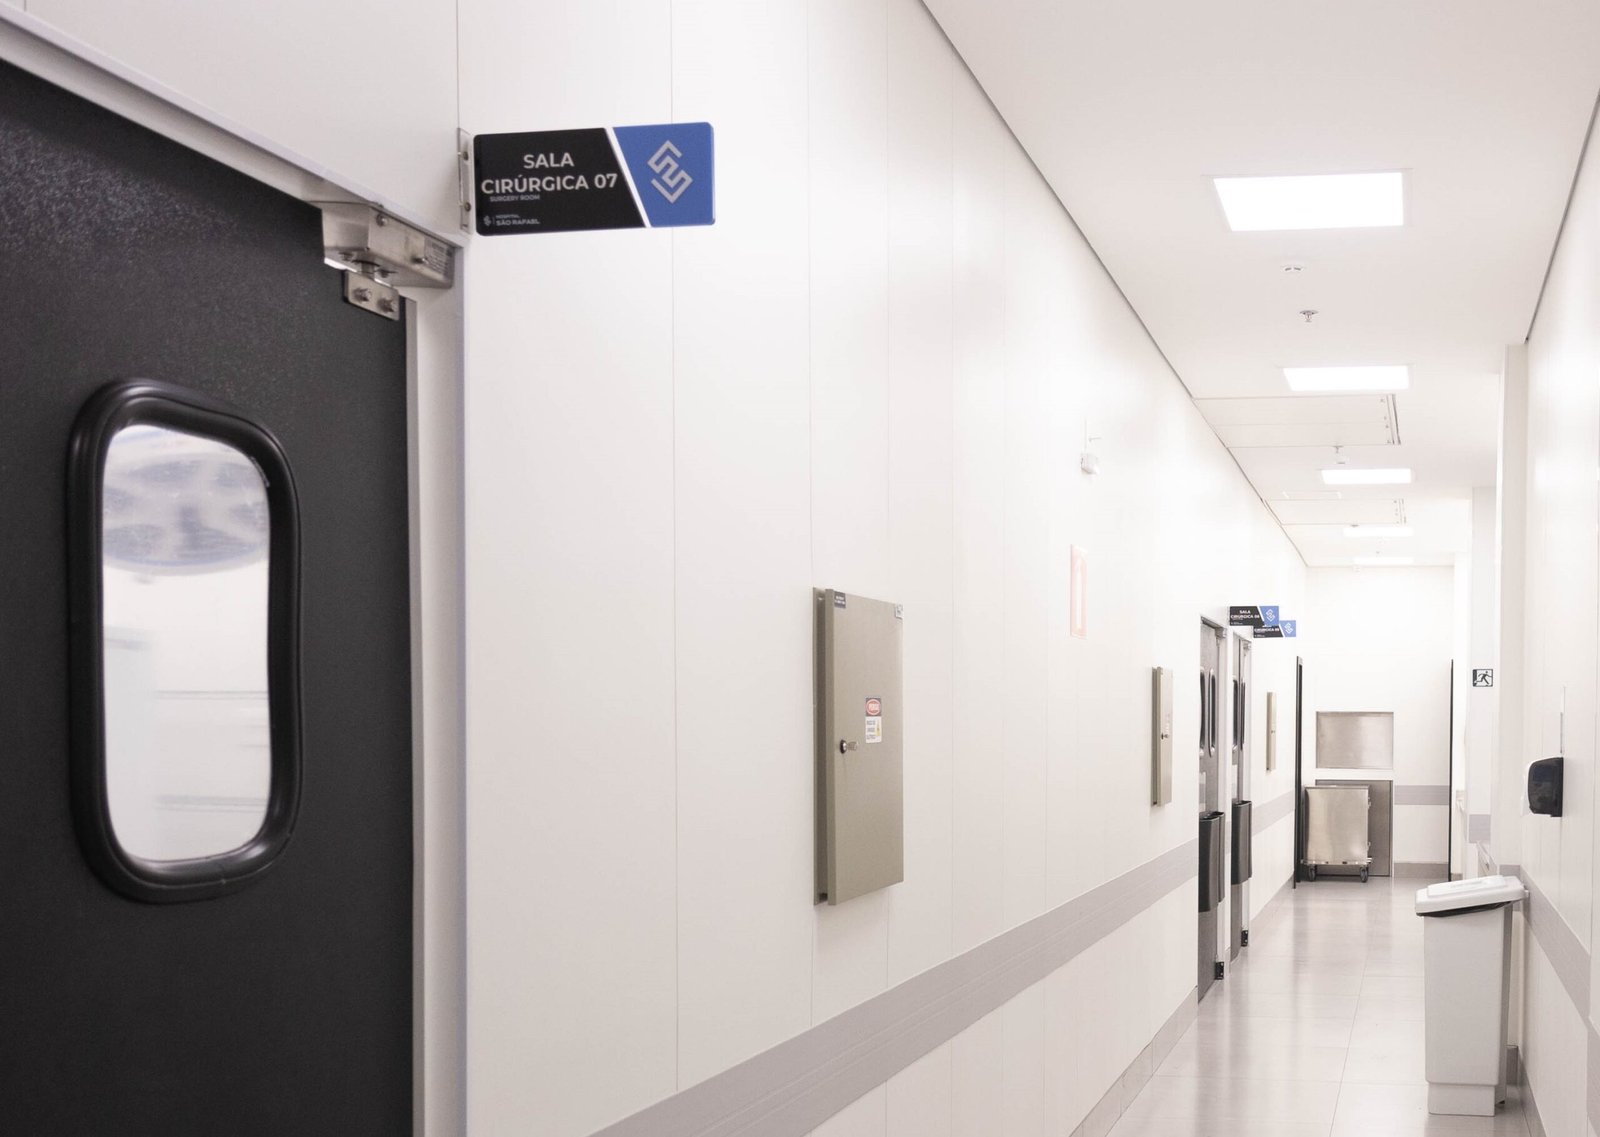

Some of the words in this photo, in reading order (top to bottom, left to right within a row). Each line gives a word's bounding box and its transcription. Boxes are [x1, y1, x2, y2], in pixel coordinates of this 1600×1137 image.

[523, 152, 574, 169] SALA
[481, 174, 589, 194] CIRÚRGICA
[594, 173, 618, 189] 07
